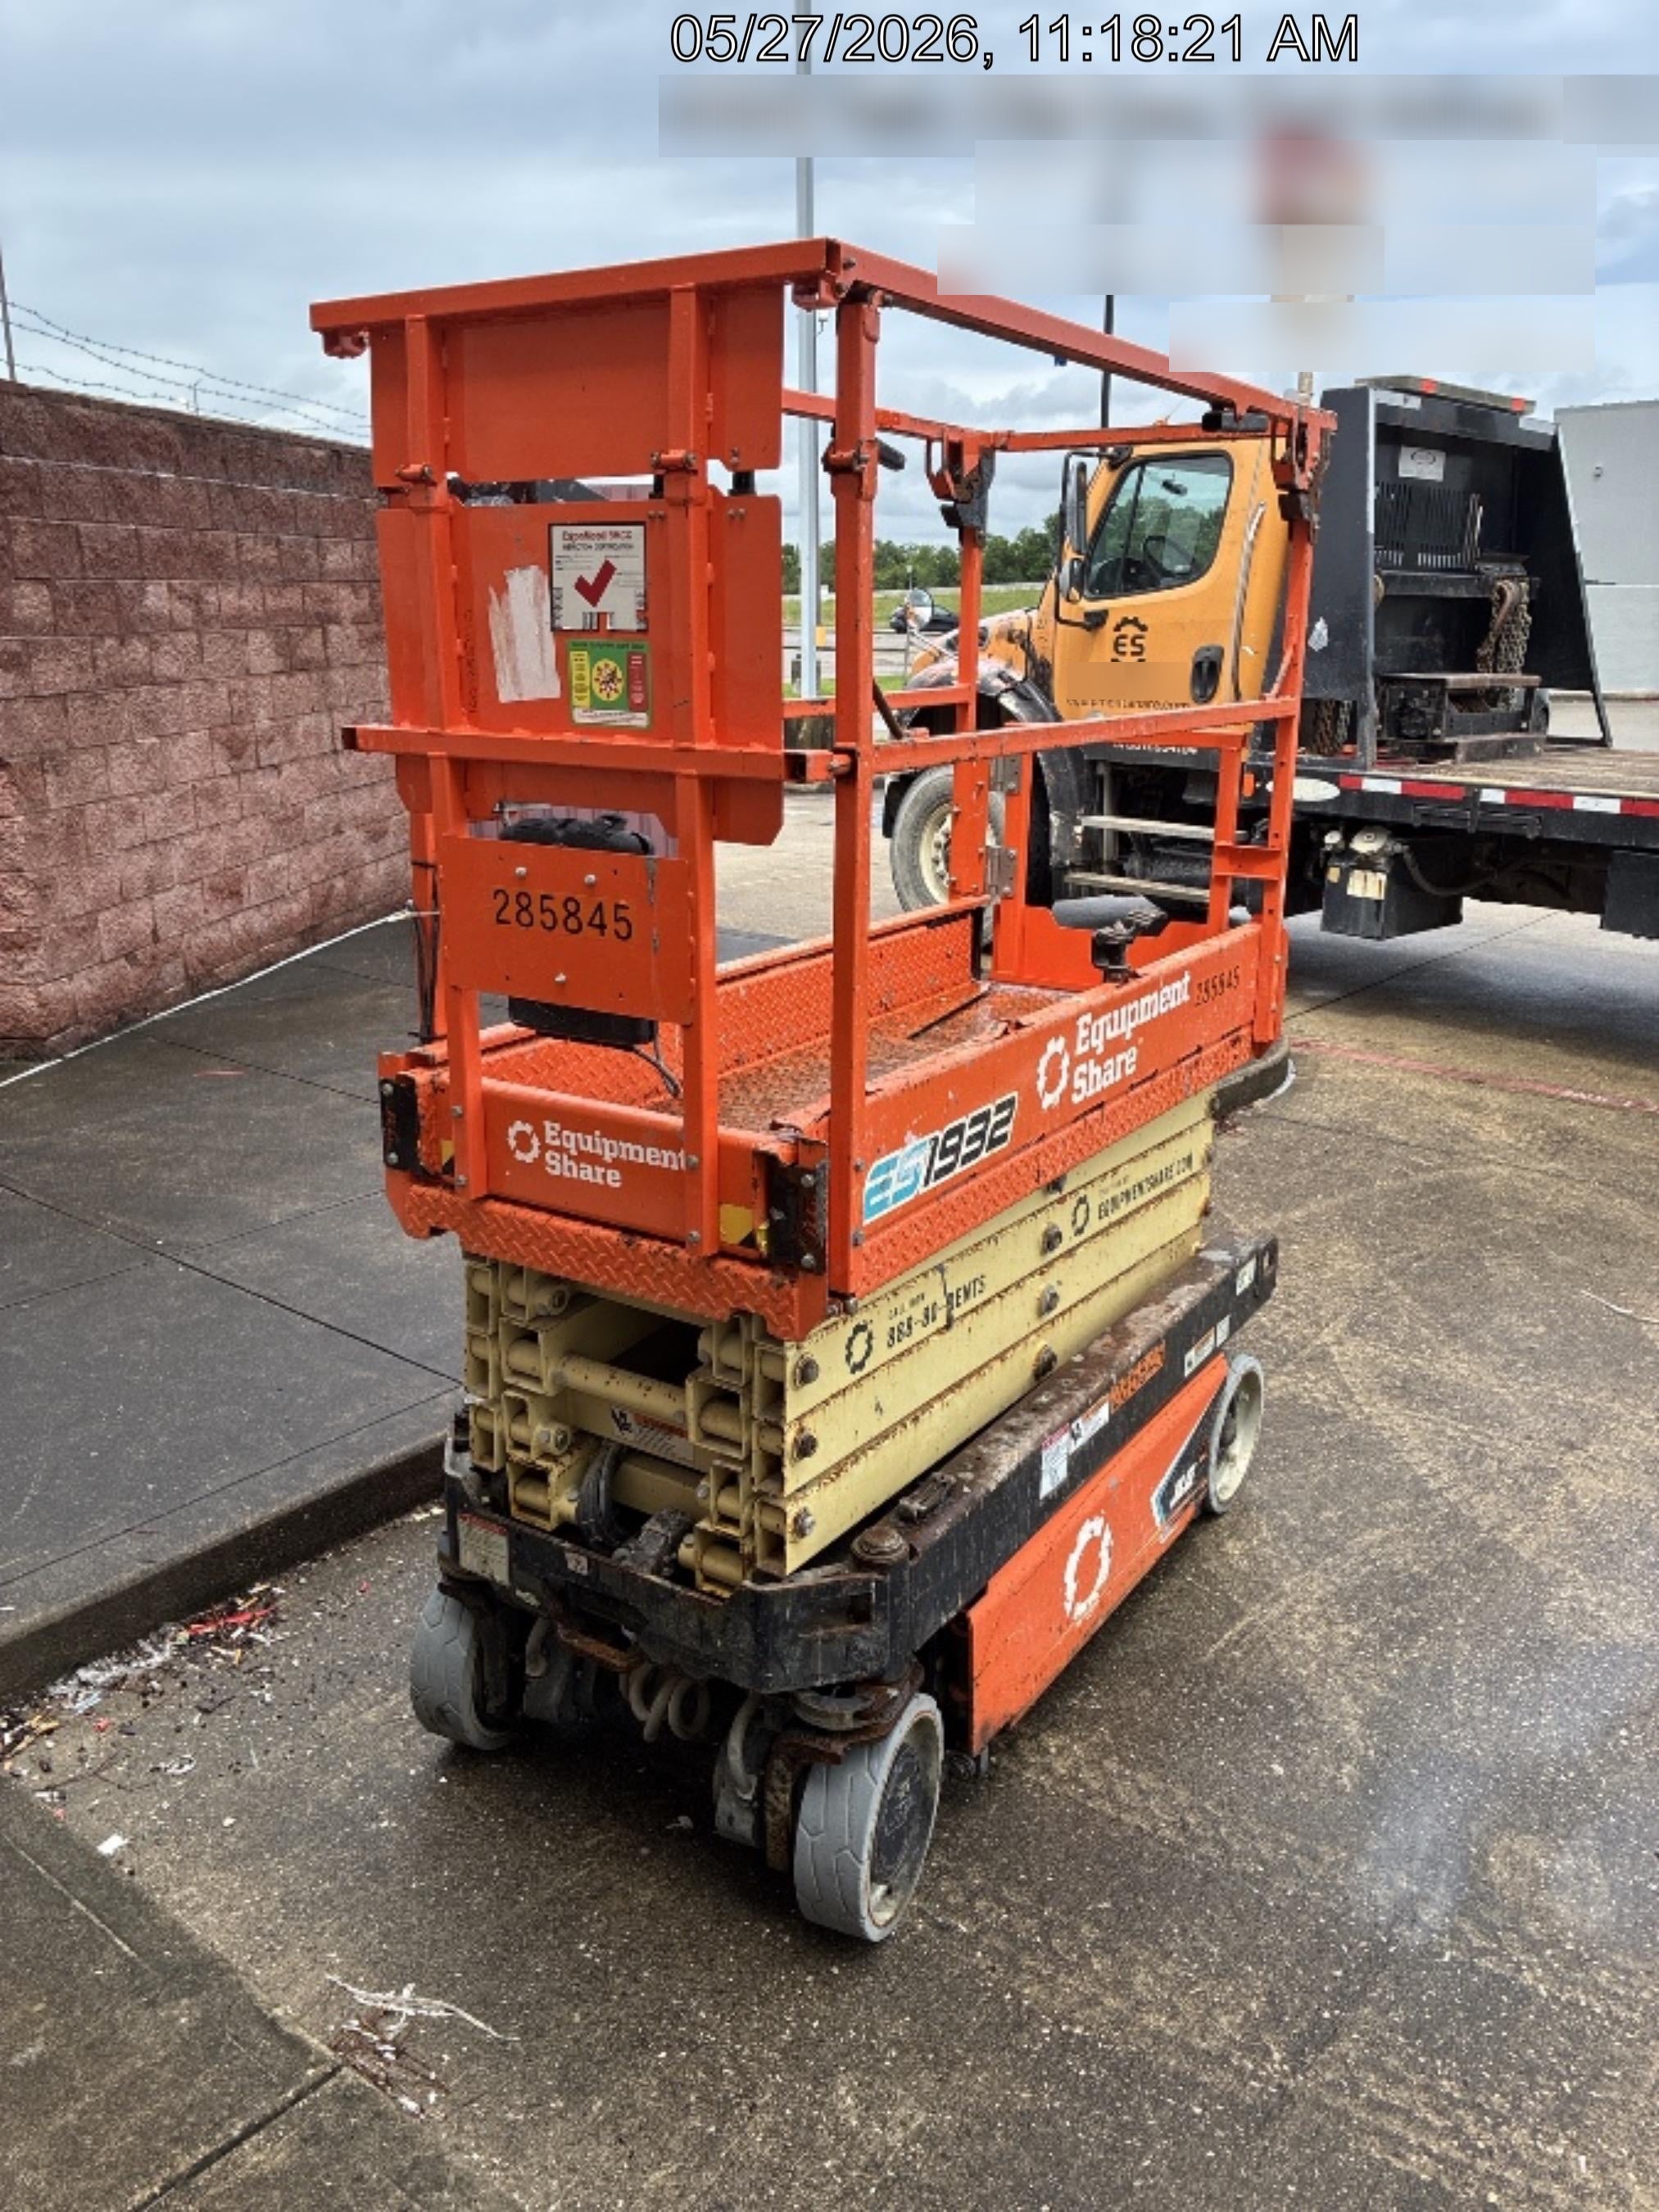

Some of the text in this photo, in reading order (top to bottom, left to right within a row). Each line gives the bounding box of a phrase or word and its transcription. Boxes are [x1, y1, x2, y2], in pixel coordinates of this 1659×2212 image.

[1113, 633, 1145, 656] ES
[492, 888, 633, 941] 285845
[1074, 970, 1191, 1055] Equipment
[1071, 1045, 1139, 1104] Share
[544, 1149, 623, 1189] Share
